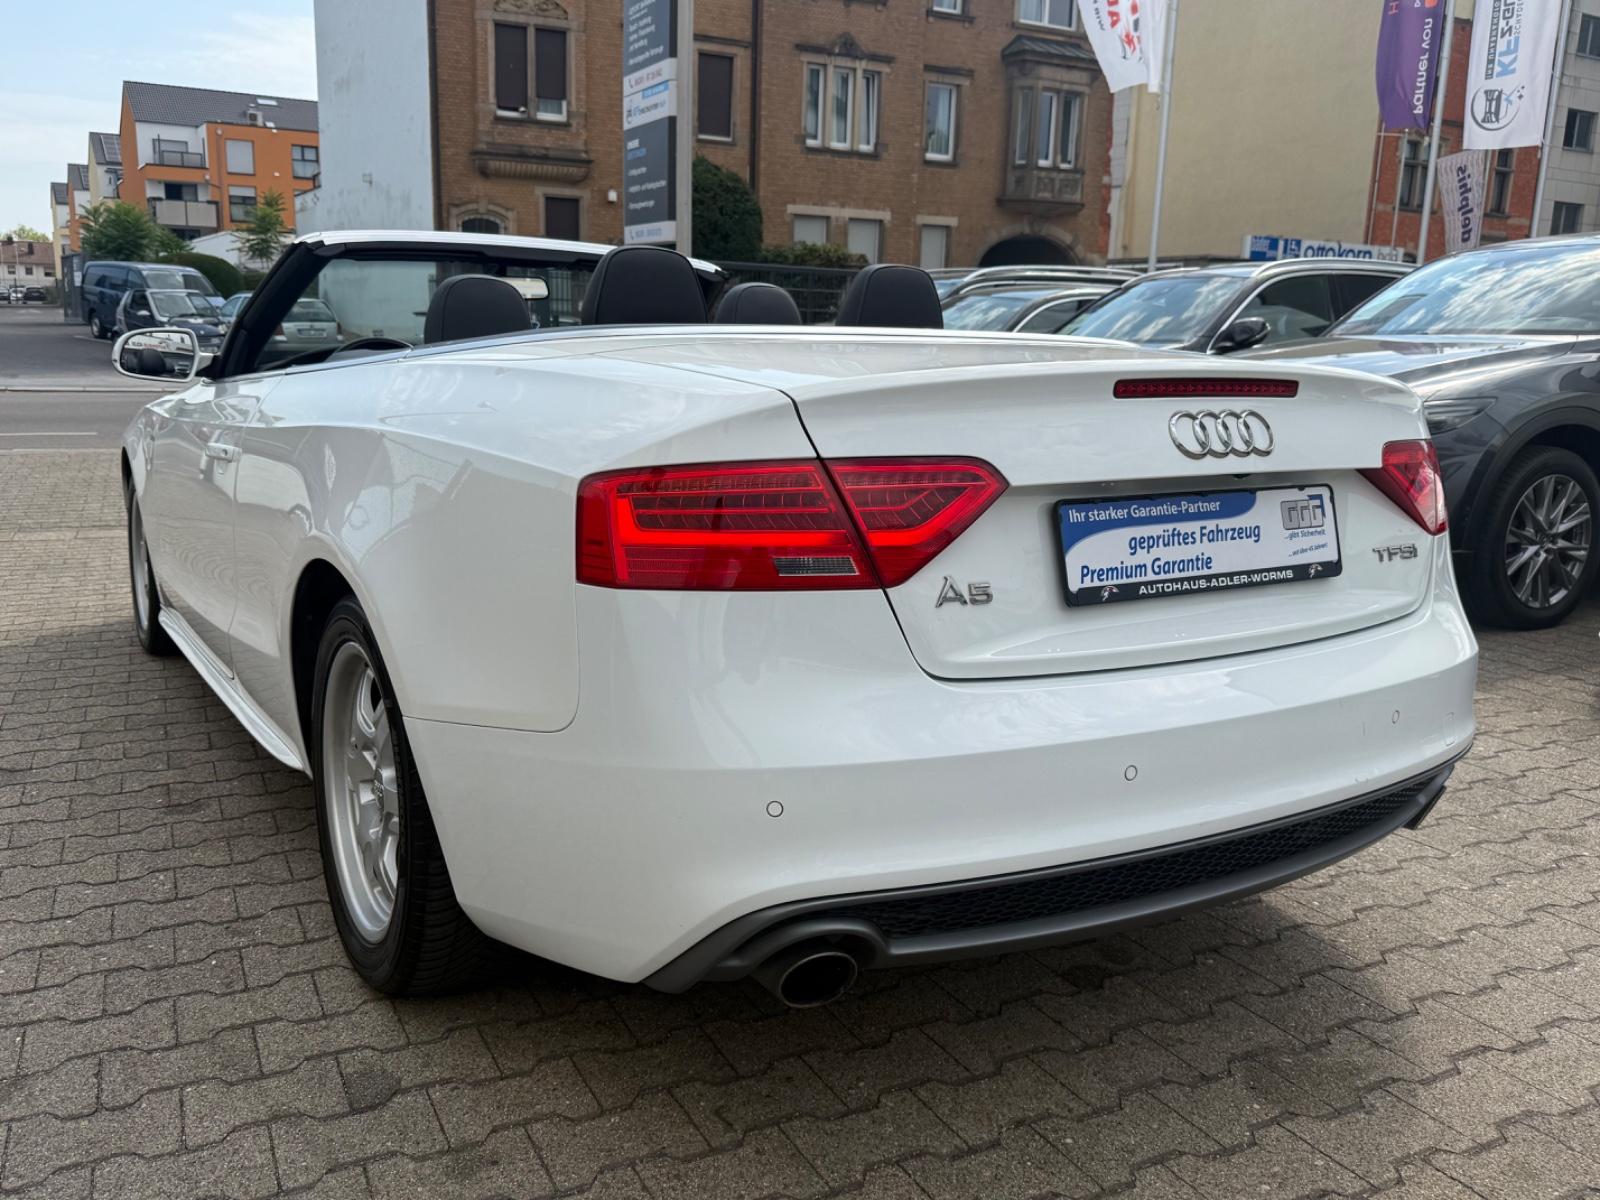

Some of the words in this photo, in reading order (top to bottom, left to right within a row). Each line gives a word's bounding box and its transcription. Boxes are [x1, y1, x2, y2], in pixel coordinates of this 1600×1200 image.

[1069, 509, 1086, 523] Ihr
[1088, 506, 1128, 520] starker
[1130, 501, 1221, 517] Garantie-Partner
[1129, 529, 1197, 555] geprüftes
[1199, 524, 1261, 547] Fahrzeug
[1372, 543, 1418, 562] TFSI
[1080, 561, 1147, 584] Premium
[1151, 552, 1213, 575] Garantie
[1139, 569, 1294, 595] AUTOHAUS-ADLER-WORMS
[935, 575, 994, 608] A5
